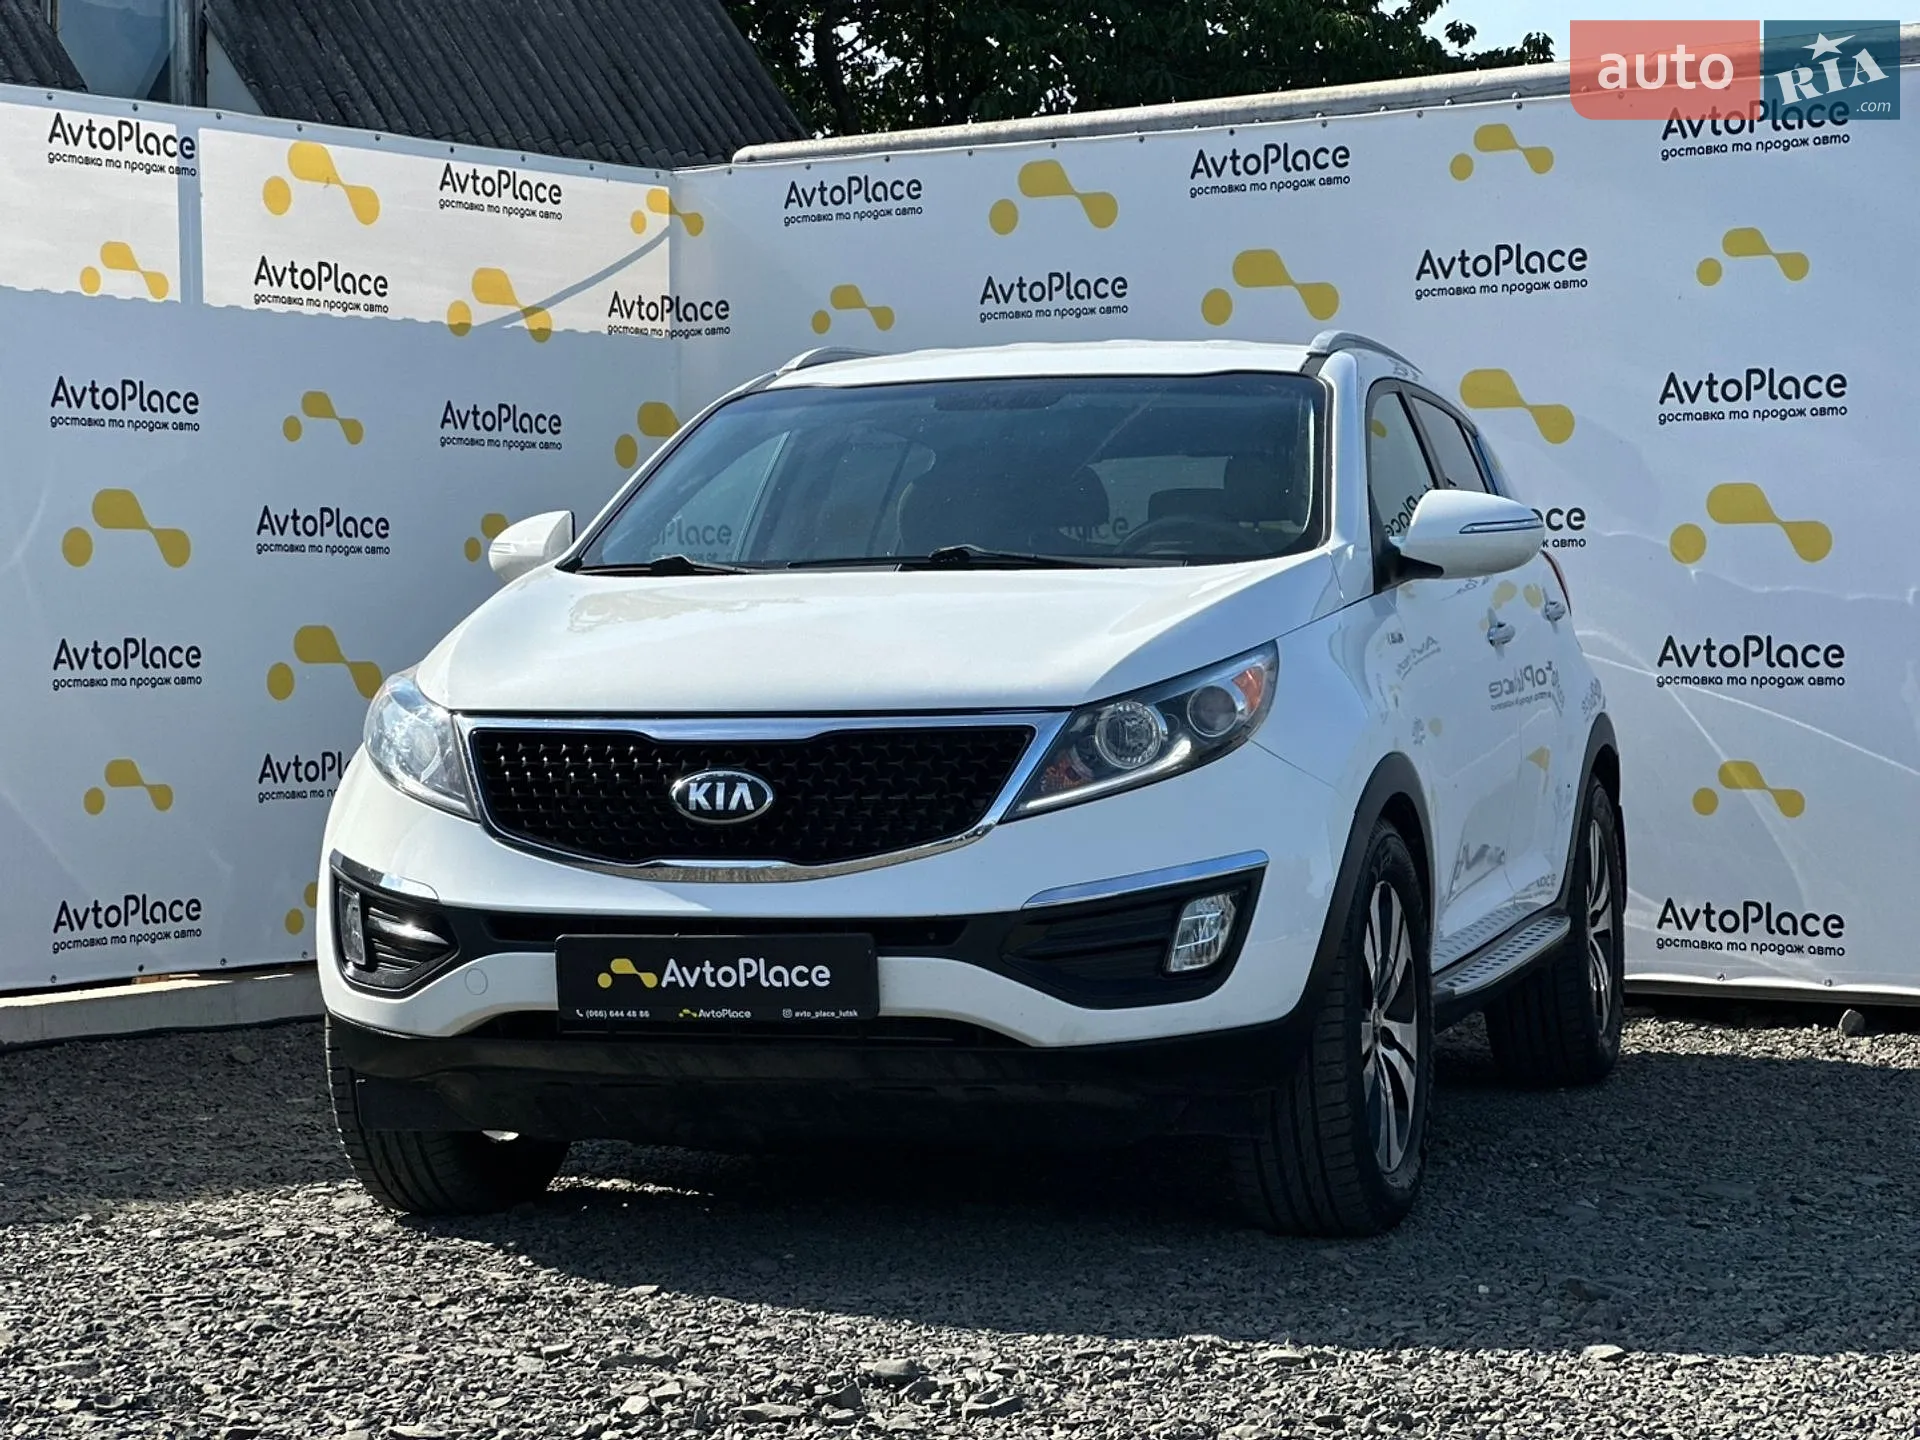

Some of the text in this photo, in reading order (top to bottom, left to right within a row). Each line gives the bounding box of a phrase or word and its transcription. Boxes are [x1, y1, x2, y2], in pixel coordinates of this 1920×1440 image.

[1661, 99, 1850, 141] AvtoPlace
[48, 114, 199, 160] AvtoPlace
[1660, 133, 1851, 162] доставка та продаж авто
[47, 151, 200, 177] доставка та продаж авто
[1190, 142, 1350, 180] AvtoPlace
[439, 162, 562, 205] AvtoPlace
[784, 174, 922, 210] AvtoPlace
[1189, 175, 1351, 199] доставка та продаж авто
[438, 198, 563, 221] доставка та продаж авто
[783, 206, 923, 228] доставка та продаж авто
[1415, 243, 1588, 281] AvtoPlace
[254, 255, 388, 298] AvtoPlace
[980, 271, 1128, 305] AvtoPlace
[1414, 278, 1588, 301] доставка та продаж авто
[253, 293, 389, 314] доставка та продаж авто
[608, 290, 730, 323] AvtoPlace
[979, 304, 1129, 324] доставка та продаж авто
[607, 322, 731, 340] доставка та продаж авто
[50, 378, 199, 415] AvtoPlace
[1659, 369, 1847, 406] AvtoPlace
[49, 415, 200, 433] доставка та продаж авто
[440, 400, 562, 436] AvtoPlace
[1657, 405, 1848, 426] доставка та продаж авто
[439, 435, 563, 452] доставка та продаж авто
[256, 505, 390, 540] AvtoPlace
[255, 542, 391, 558] доставка та продаж авто
[1551, 538, 1587, 548] авто
[53, 637, 202, 671] AvtoPlace
[1657, 636, 1845, 669] AvtoPlace
[51, 675, 203, 692] доставка та продаж авто
[1656, 675, 1846, 689] доставка та продаж авто
[258, 751, 350, 784] AvtoPl
[309, 788, 325, 799] та
[687, 782, 755, 810] KIA
[53, 893, 202, 934] AvtoPlace
[1656, 897, 1845, 939] AvtoPlace
[51, 927, 203, 955] доставка та продаж авто
[1655, 937, 1846, 957] доставка та продаж авто
[660, 957, 831, 988] AvtoPlace
[698, 1008, 751, 1019] AvtoPlace
